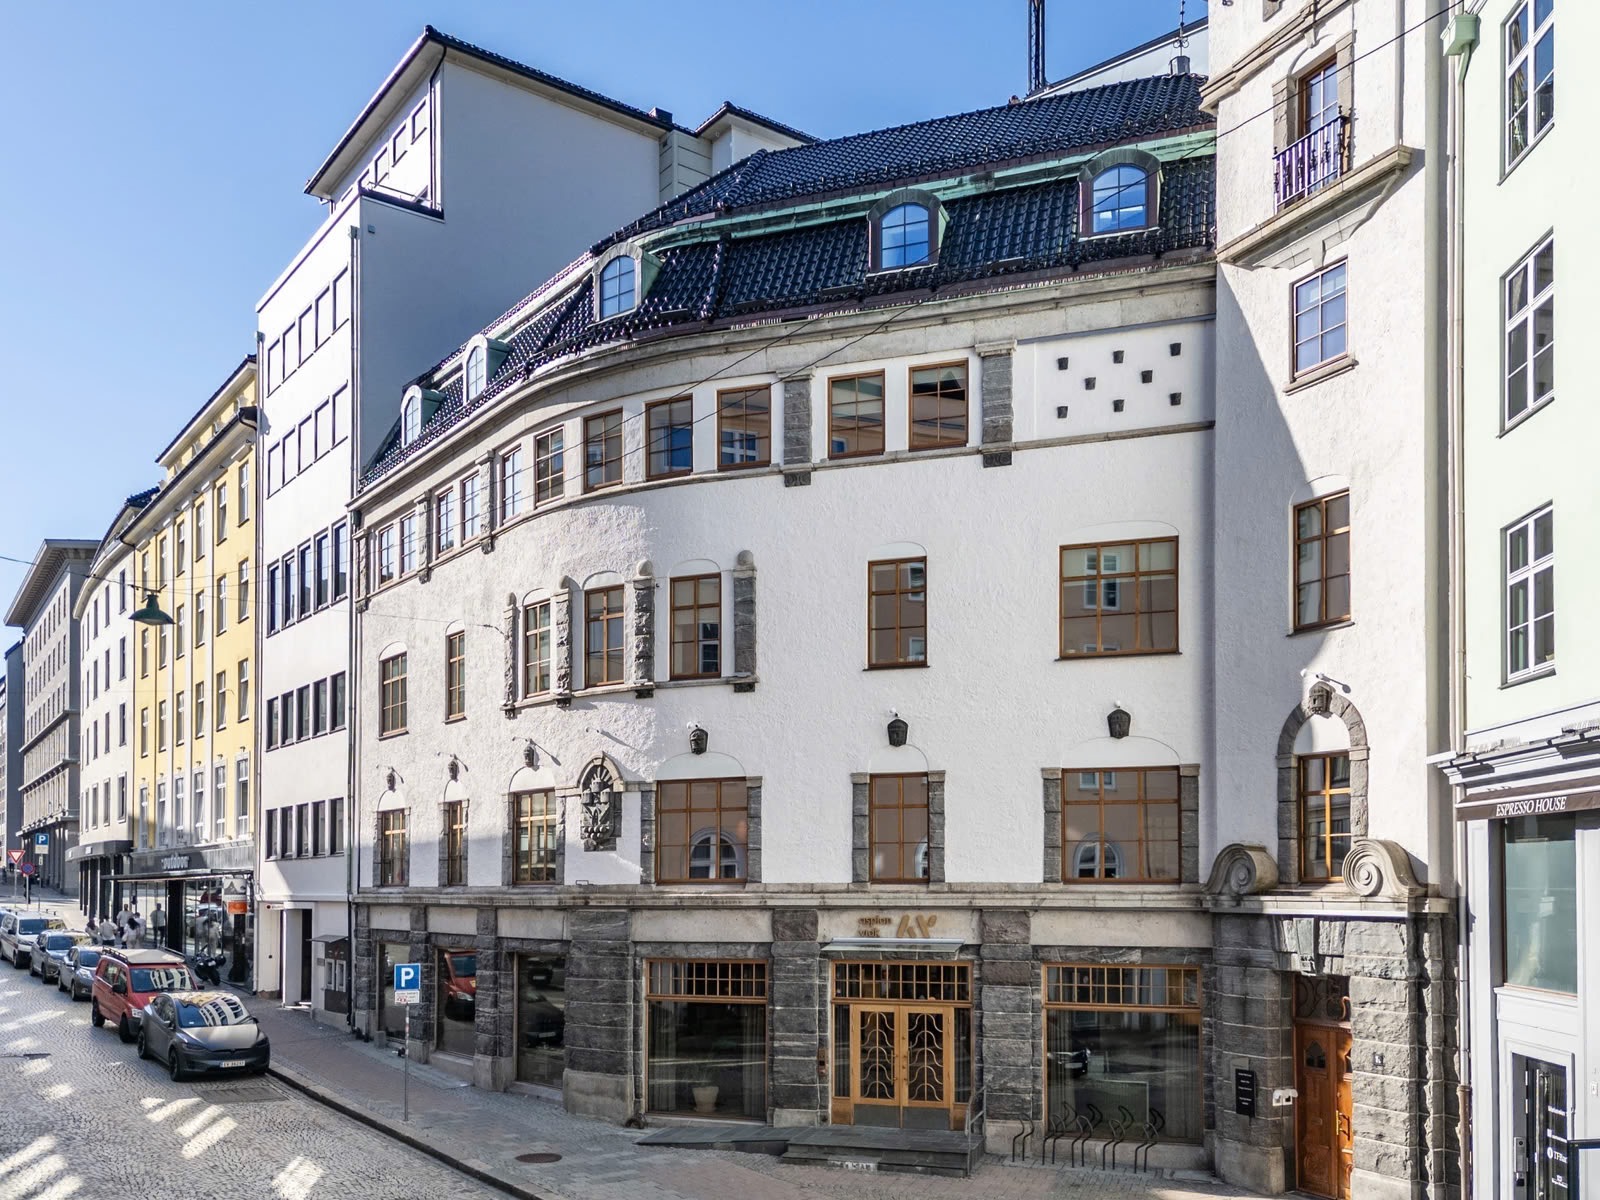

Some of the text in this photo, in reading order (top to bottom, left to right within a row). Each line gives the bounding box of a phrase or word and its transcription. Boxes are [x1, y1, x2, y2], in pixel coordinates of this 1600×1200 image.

[1496, 797, 1567, 817] ESPRESSO HOUSE
[38, 835, 46, 844] P
[401, 967, 414, 988] P
